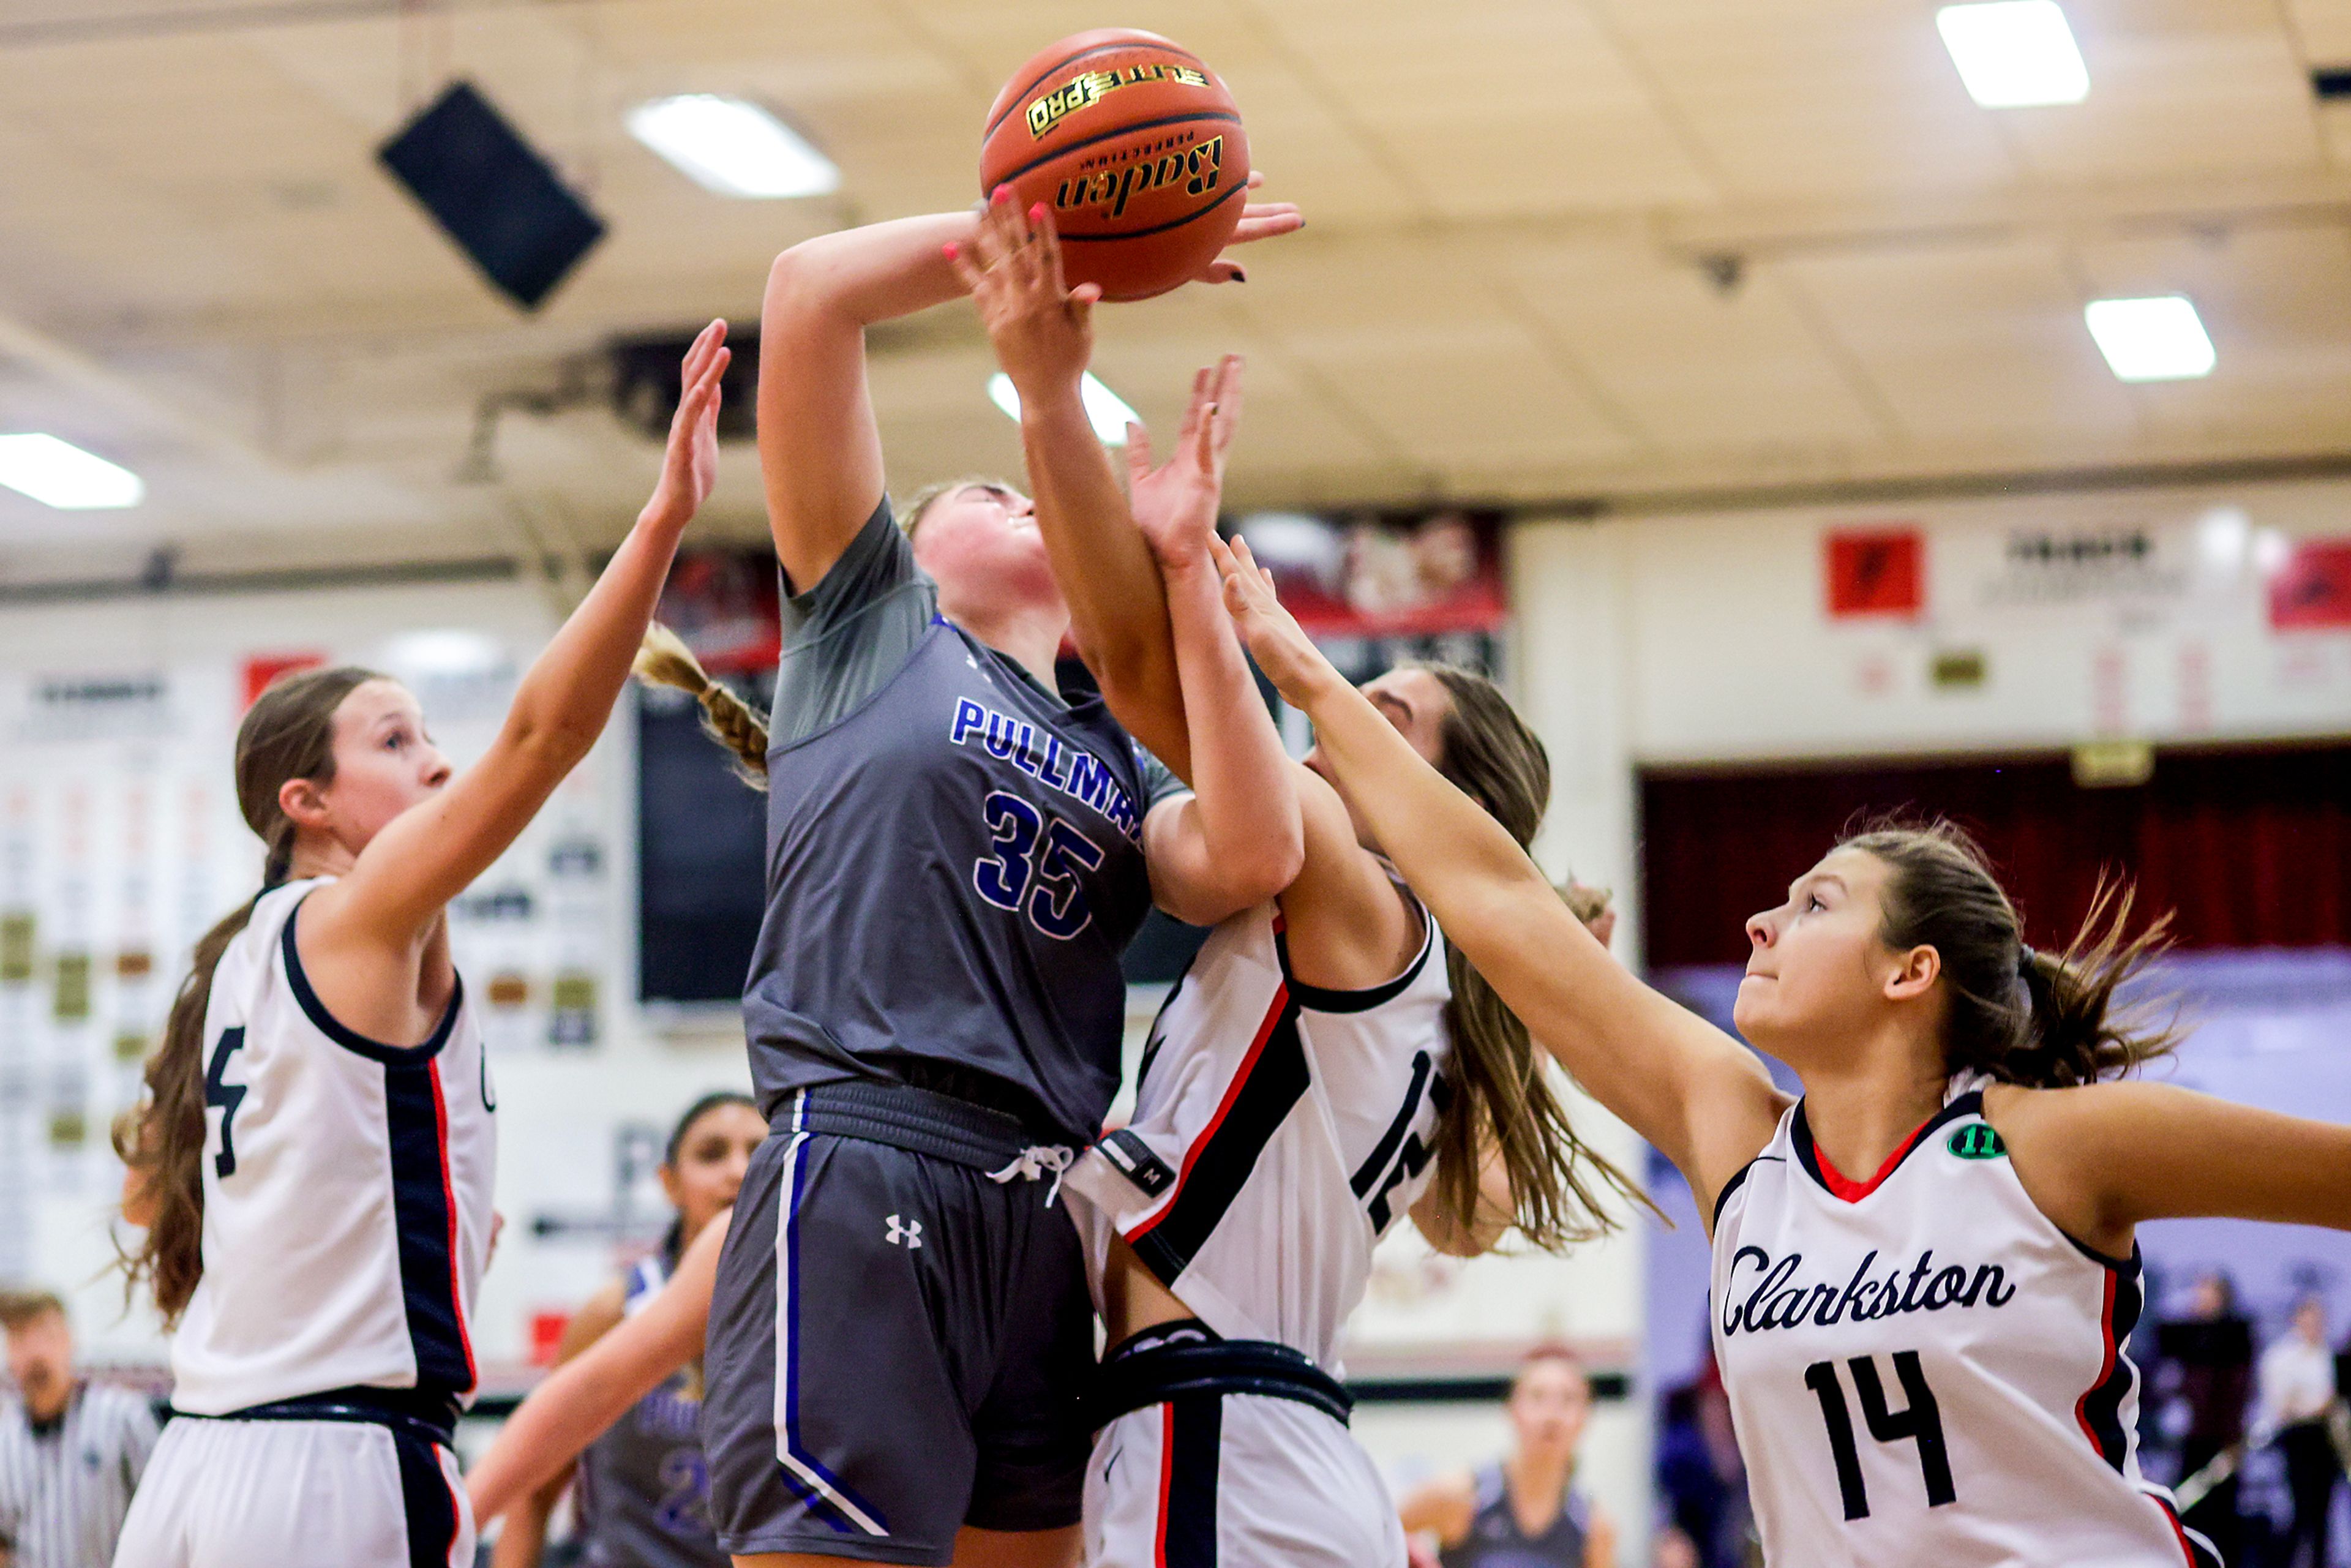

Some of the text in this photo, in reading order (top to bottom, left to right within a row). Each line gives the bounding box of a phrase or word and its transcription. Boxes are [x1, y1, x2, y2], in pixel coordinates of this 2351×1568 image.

[1027, 80, 1084, 137] PRO
[1056, 135, 1223, 220] Baden
[973, 790, 1105, 940] 35
[1962, 1125, 1997, 1154] 11
[1723, 1245, 2016, 1337] Clarkston
[1805, 1350, 1957, 1522] 14
